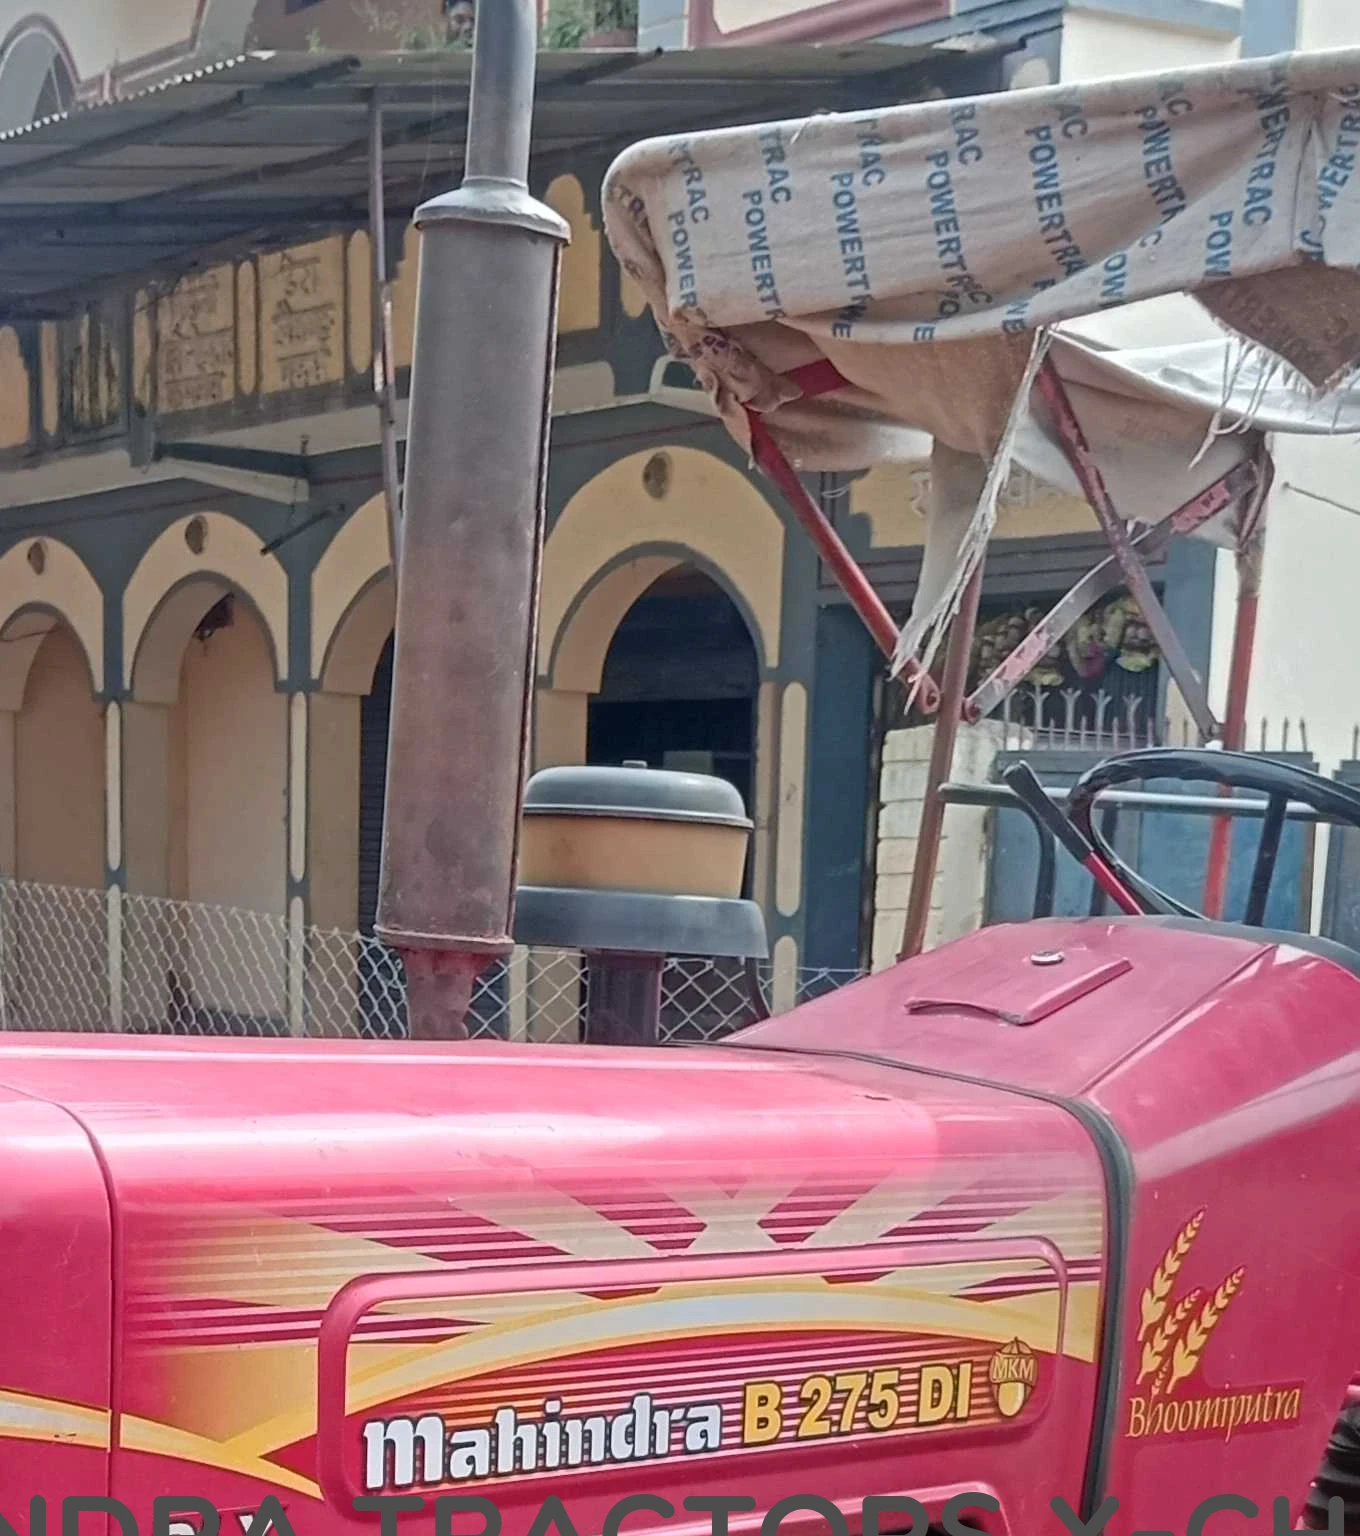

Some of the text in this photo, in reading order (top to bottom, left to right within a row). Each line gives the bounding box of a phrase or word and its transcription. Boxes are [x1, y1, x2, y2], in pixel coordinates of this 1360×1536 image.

[991, 1354, 1034, 1380] MKM
[362, 1361, 974, 1490] Mahindra B 275 DI
